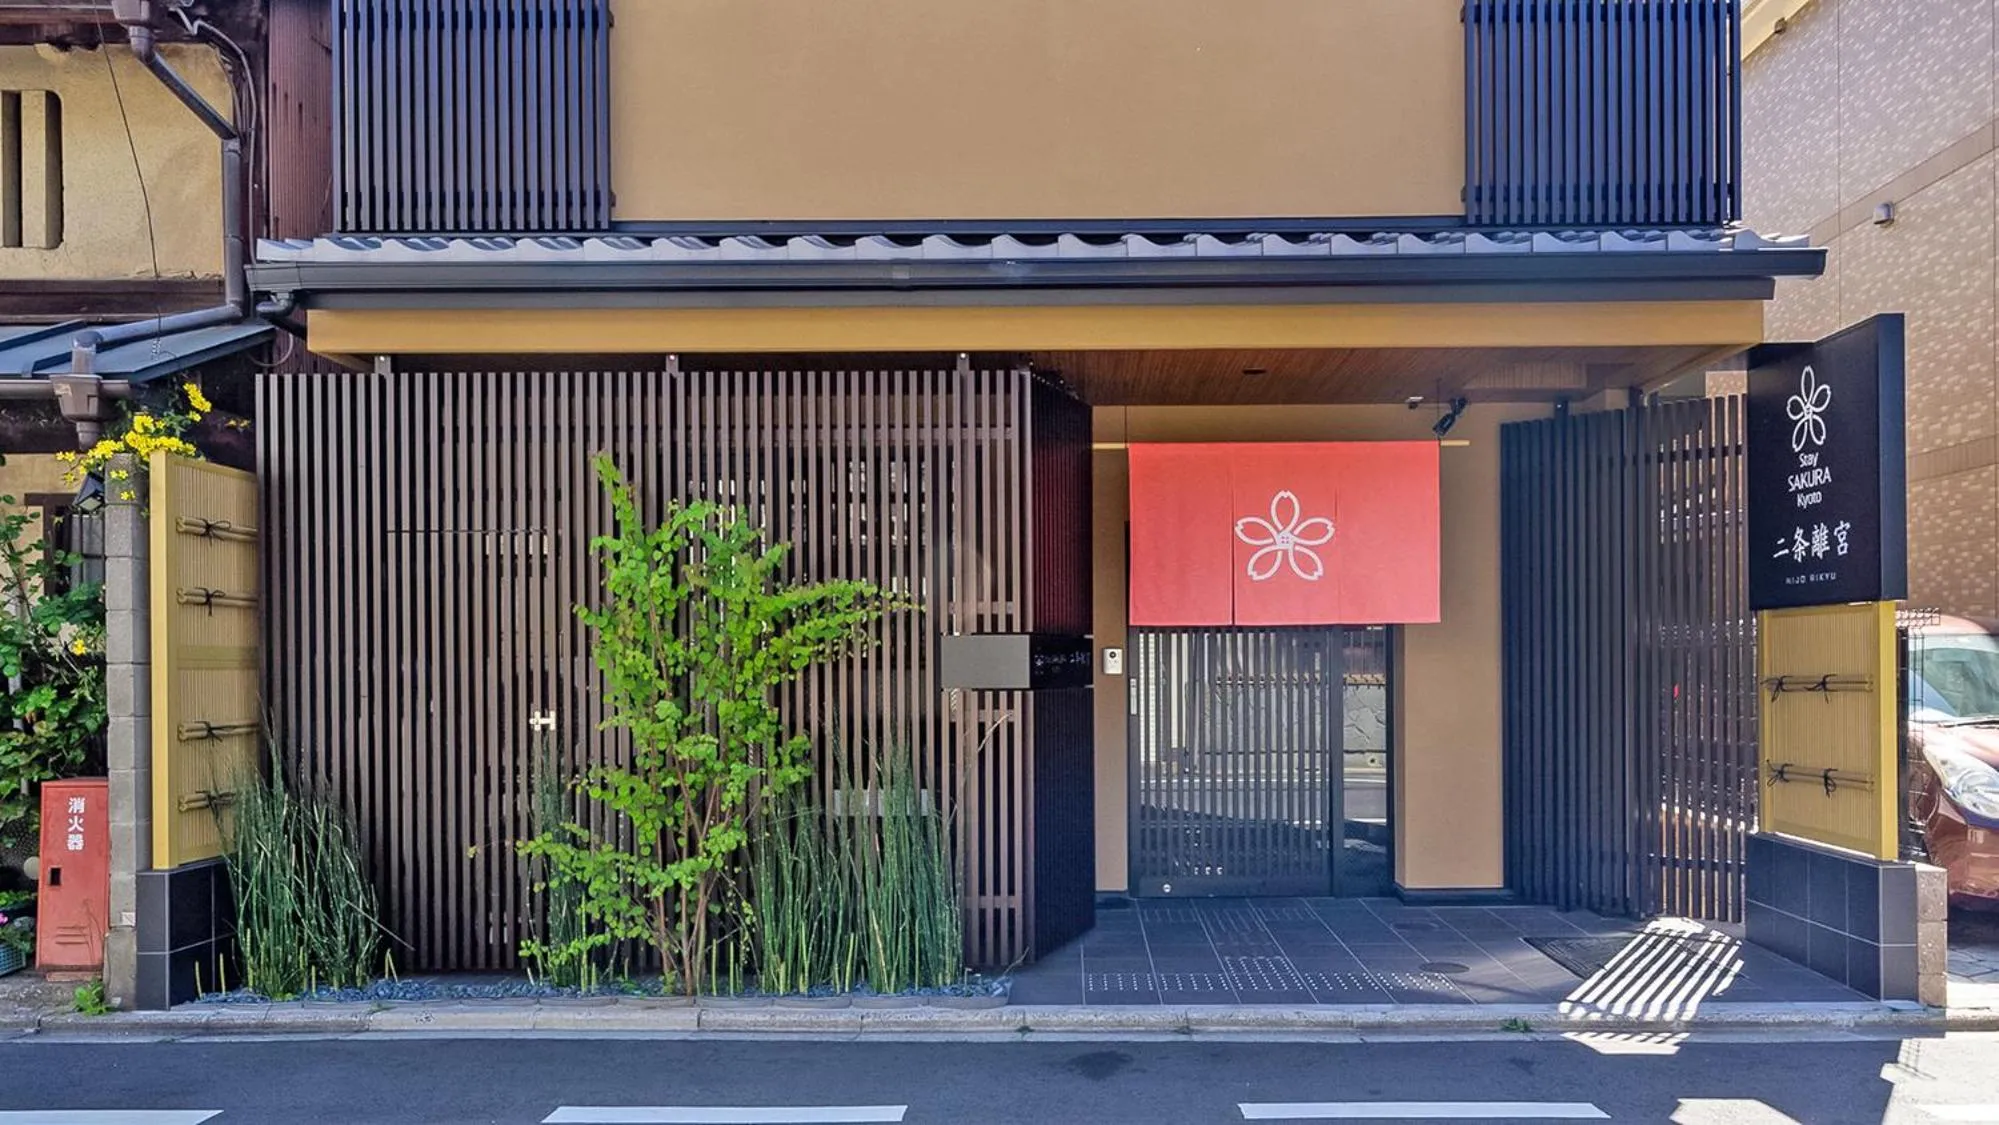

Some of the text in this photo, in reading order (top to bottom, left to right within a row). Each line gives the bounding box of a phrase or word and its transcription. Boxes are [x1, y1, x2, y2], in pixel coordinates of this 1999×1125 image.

[1799, 452, 1818, 468] Stay
[1788, 466, 1832, 492] SAKURA
[1797, 491, 1822, 509] Kyoto
[1773, 520, 1851, 563] 二条離宮
[67, 796, 87, 851] 消火器
